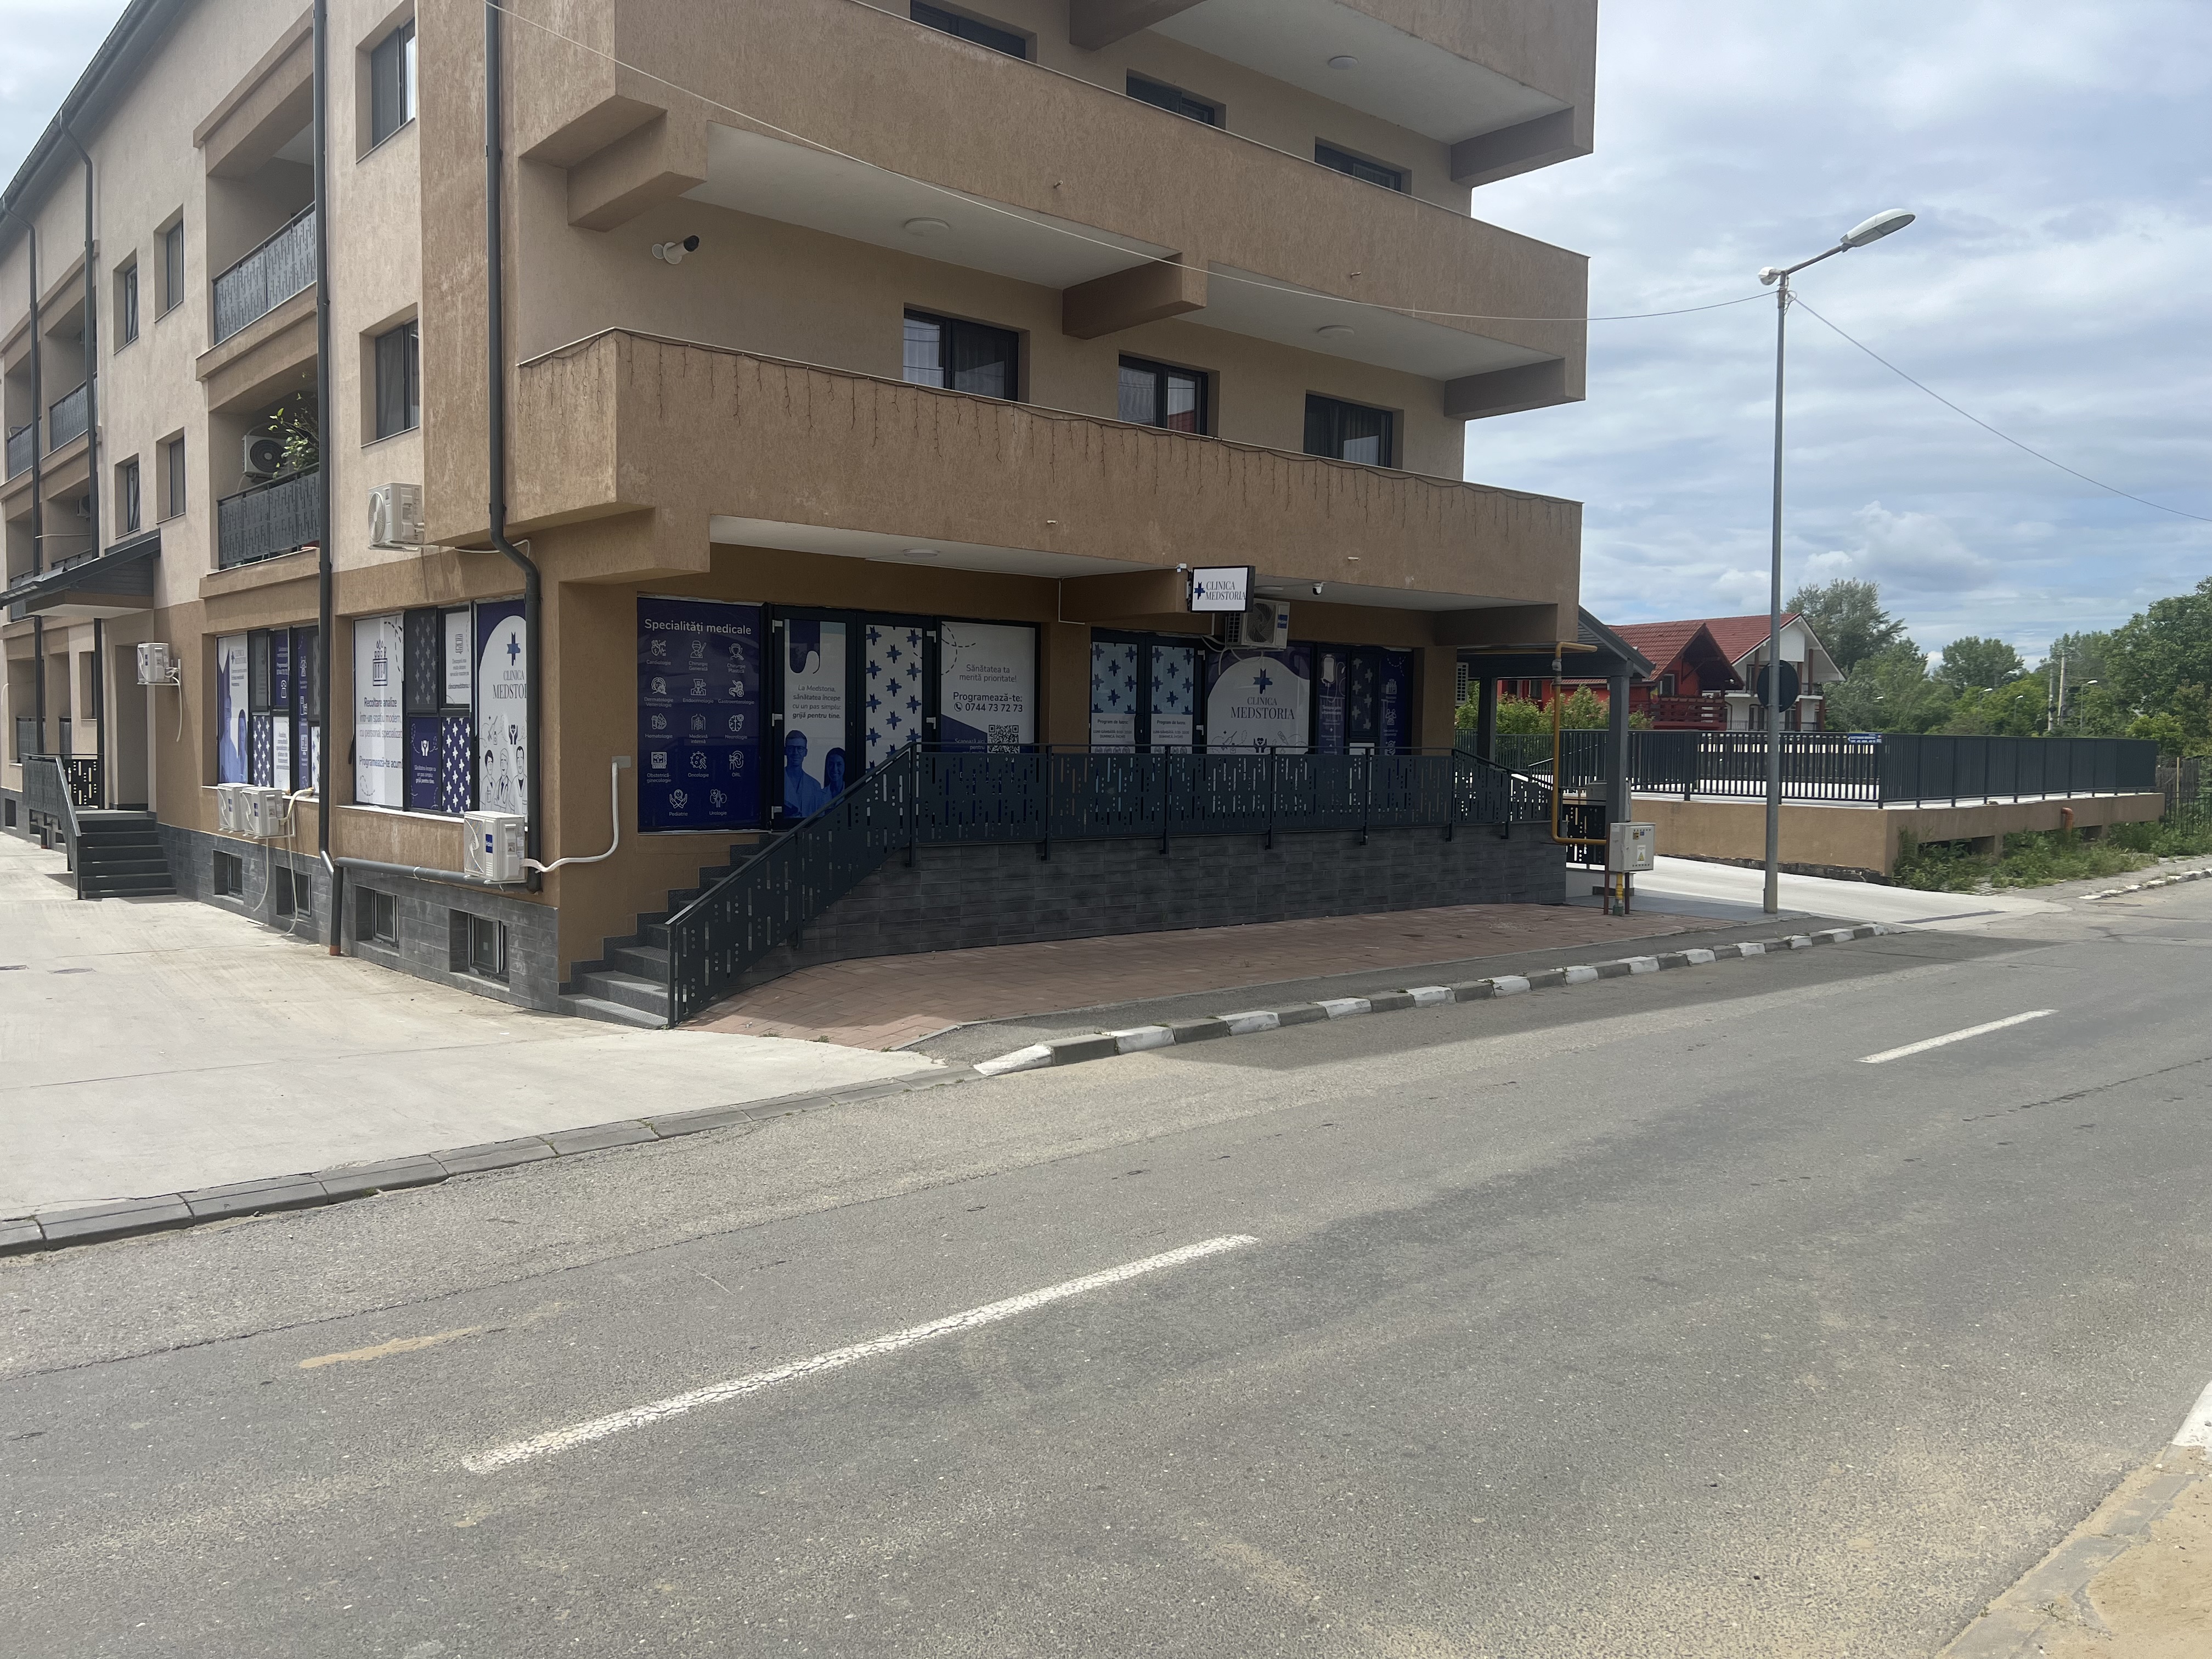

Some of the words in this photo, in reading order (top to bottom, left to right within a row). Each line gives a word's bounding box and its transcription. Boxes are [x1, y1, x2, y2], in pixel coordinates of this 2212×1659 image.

[1206, 581, 1235, 590] CLINICA
[1206, 591, 1246, 601] MEDSTORIA
[645, 619, 703, 635] Specialități
[707, 624, 751, 635] medicale
[966, 664, 1001, 673] Sănătatea
[503, 670, 524, 681] CLINICA
[493, 684, 527, 699] MEDSTO
[364, 697, 382, 707] Recoltare
[383, 697, 397, 707] analize
[953, 692, 1023, 702] Programează-te:
[1247, 696, 1277, 706] CLINICA
[966, 703, 986, 711] 0744
[1001, 704, 1011, 712] 72
[1013, 704, 1023, 712] 73
[1231, 707, 1295, 720] MEDSTORIA
